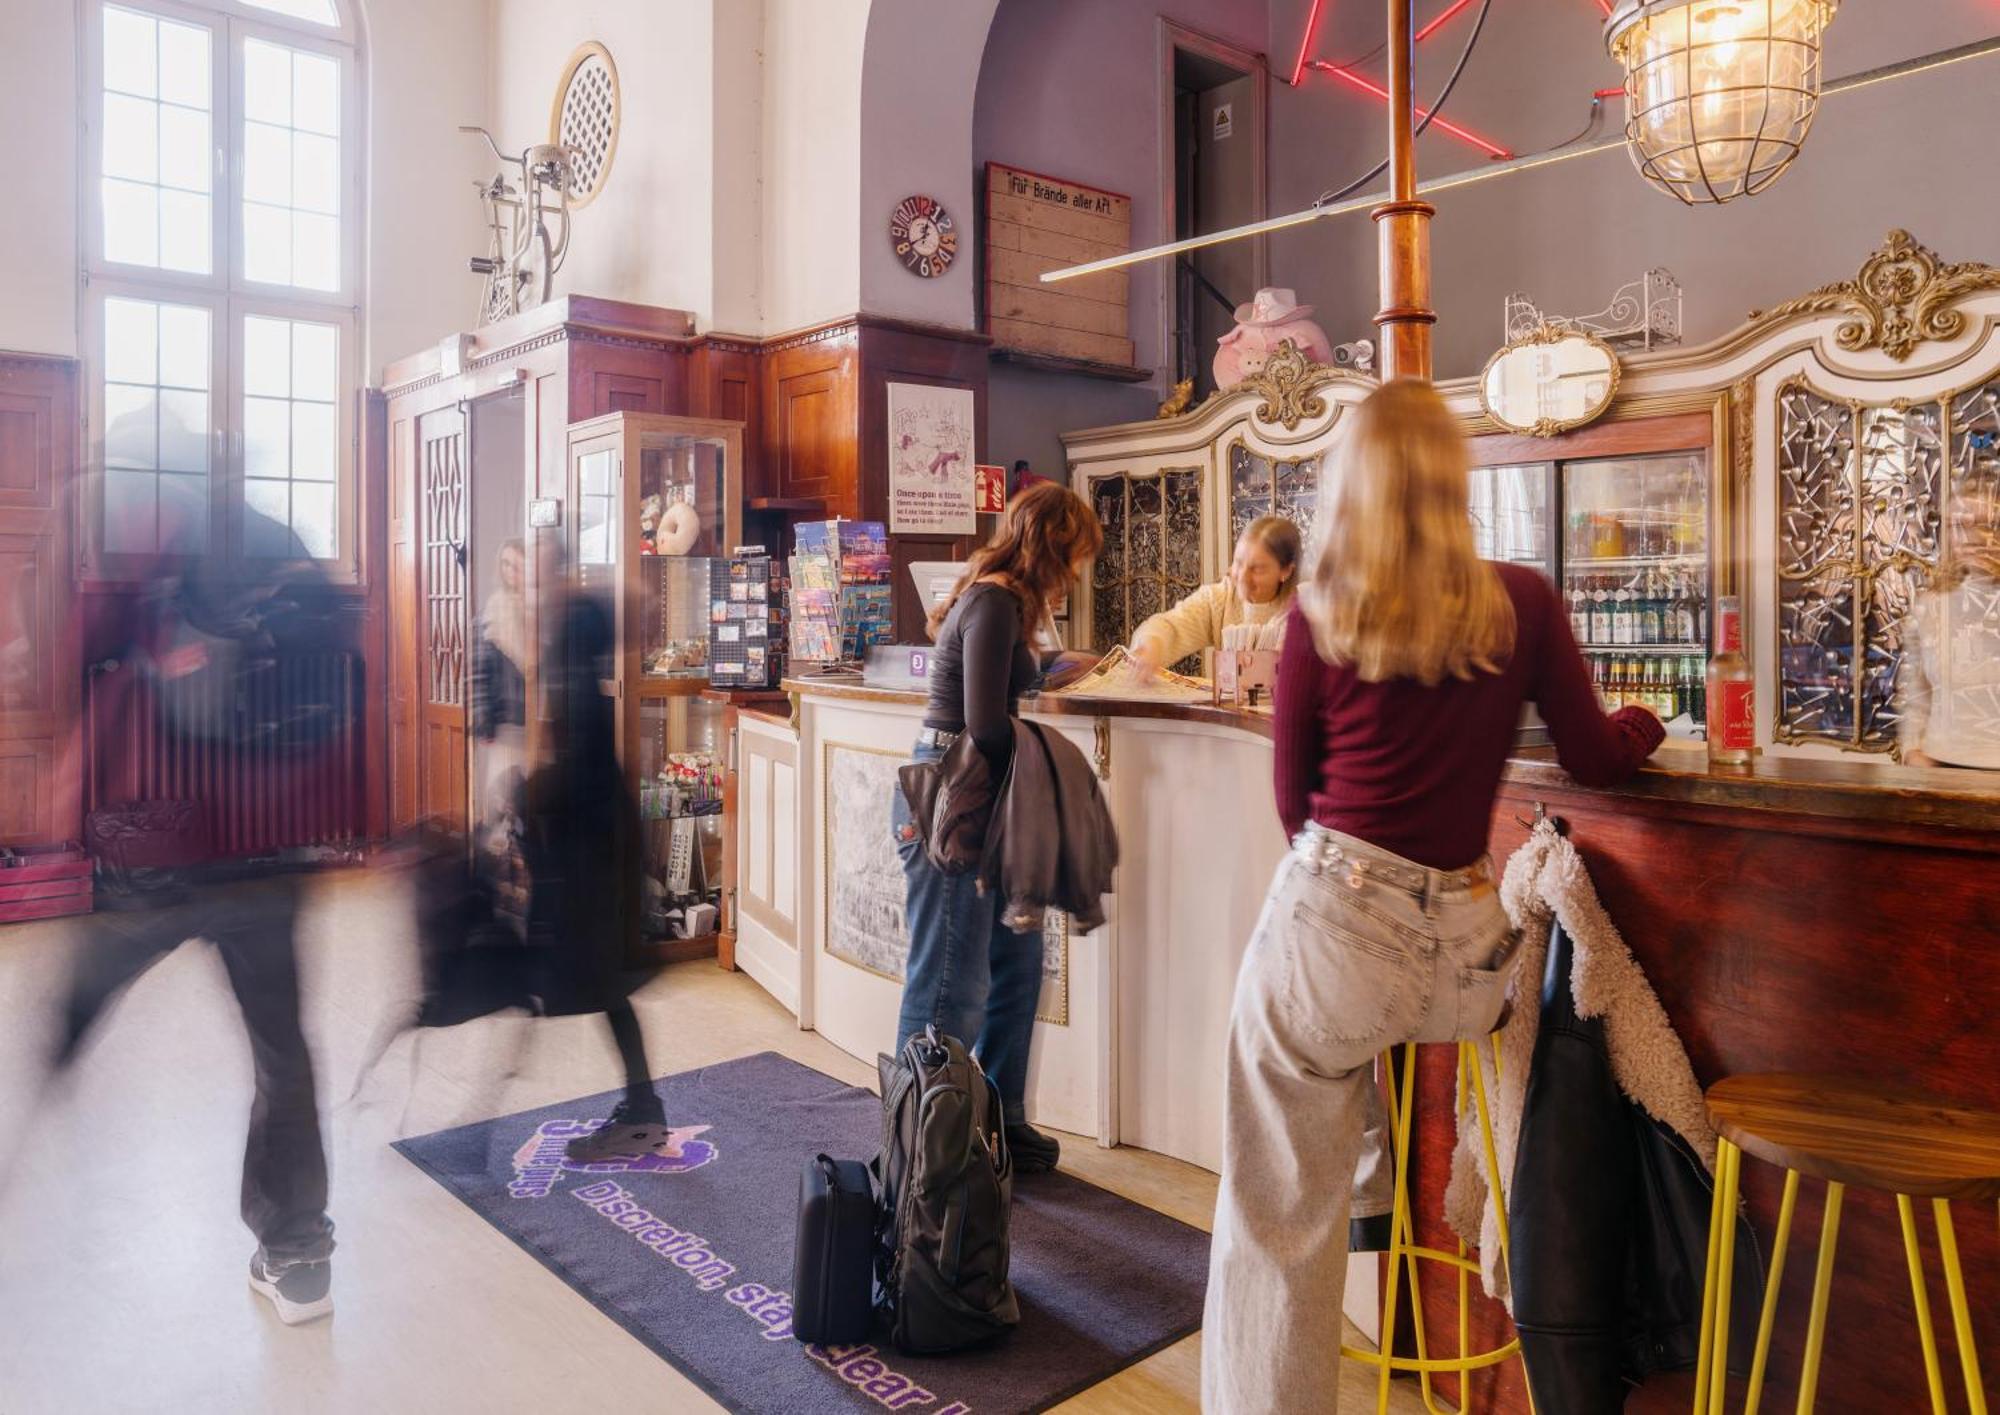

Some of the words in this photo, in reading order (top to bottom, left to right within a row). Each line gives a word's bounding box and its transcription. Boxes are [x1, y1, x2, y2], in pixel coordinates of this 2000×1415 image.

[1012, 176, 1027, 195] Für
[1034, 182, 1068, 204] Brände
[1072, 193, 1092, 210] aller
[897, 242, 911, 255] 8
[920, 257, 929, 276] 6
[931, 255, 943, 274] 5
[570, 1179, 736, 1291] Discretion,
[724, 1282, 794, 1341] stay
